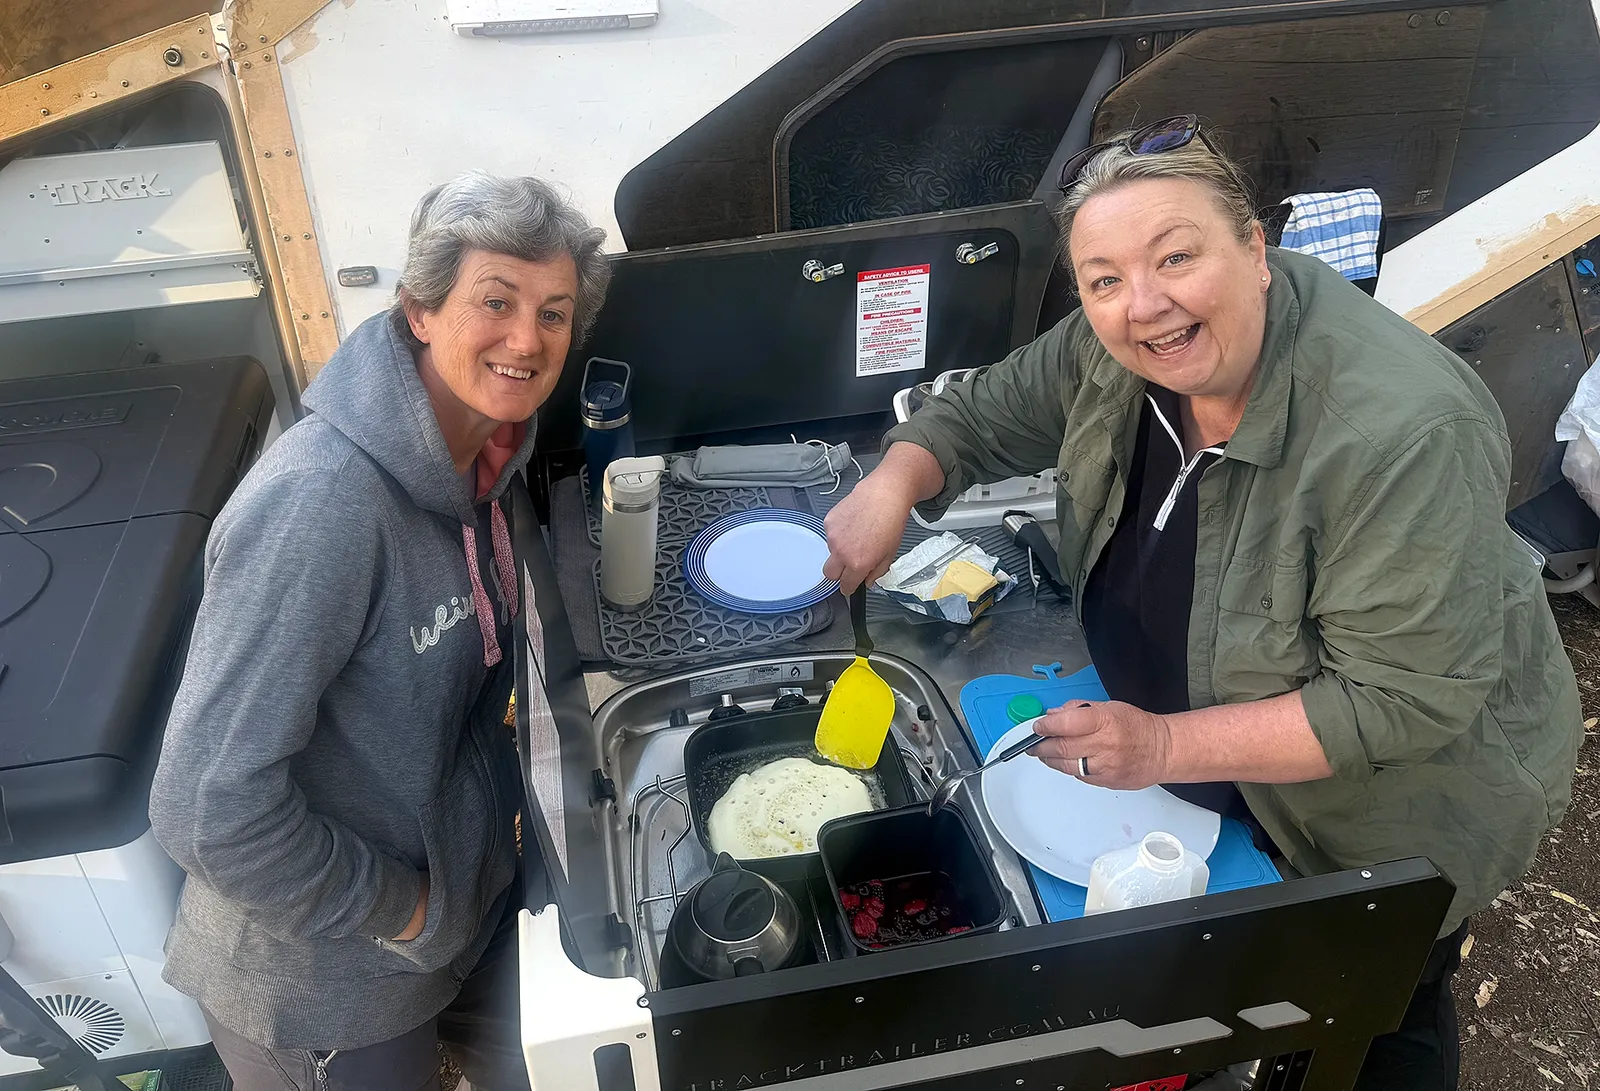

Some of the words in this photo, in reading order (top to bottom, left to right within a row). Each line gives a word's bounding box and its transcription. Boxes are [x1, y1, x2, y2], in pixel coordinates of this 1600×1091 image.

[39, 173, 172, 206] TRACK
[882, 309, 914, 317] PRECAUTIONS
[862, 341, 894, 349] COMBUSTIBLE
